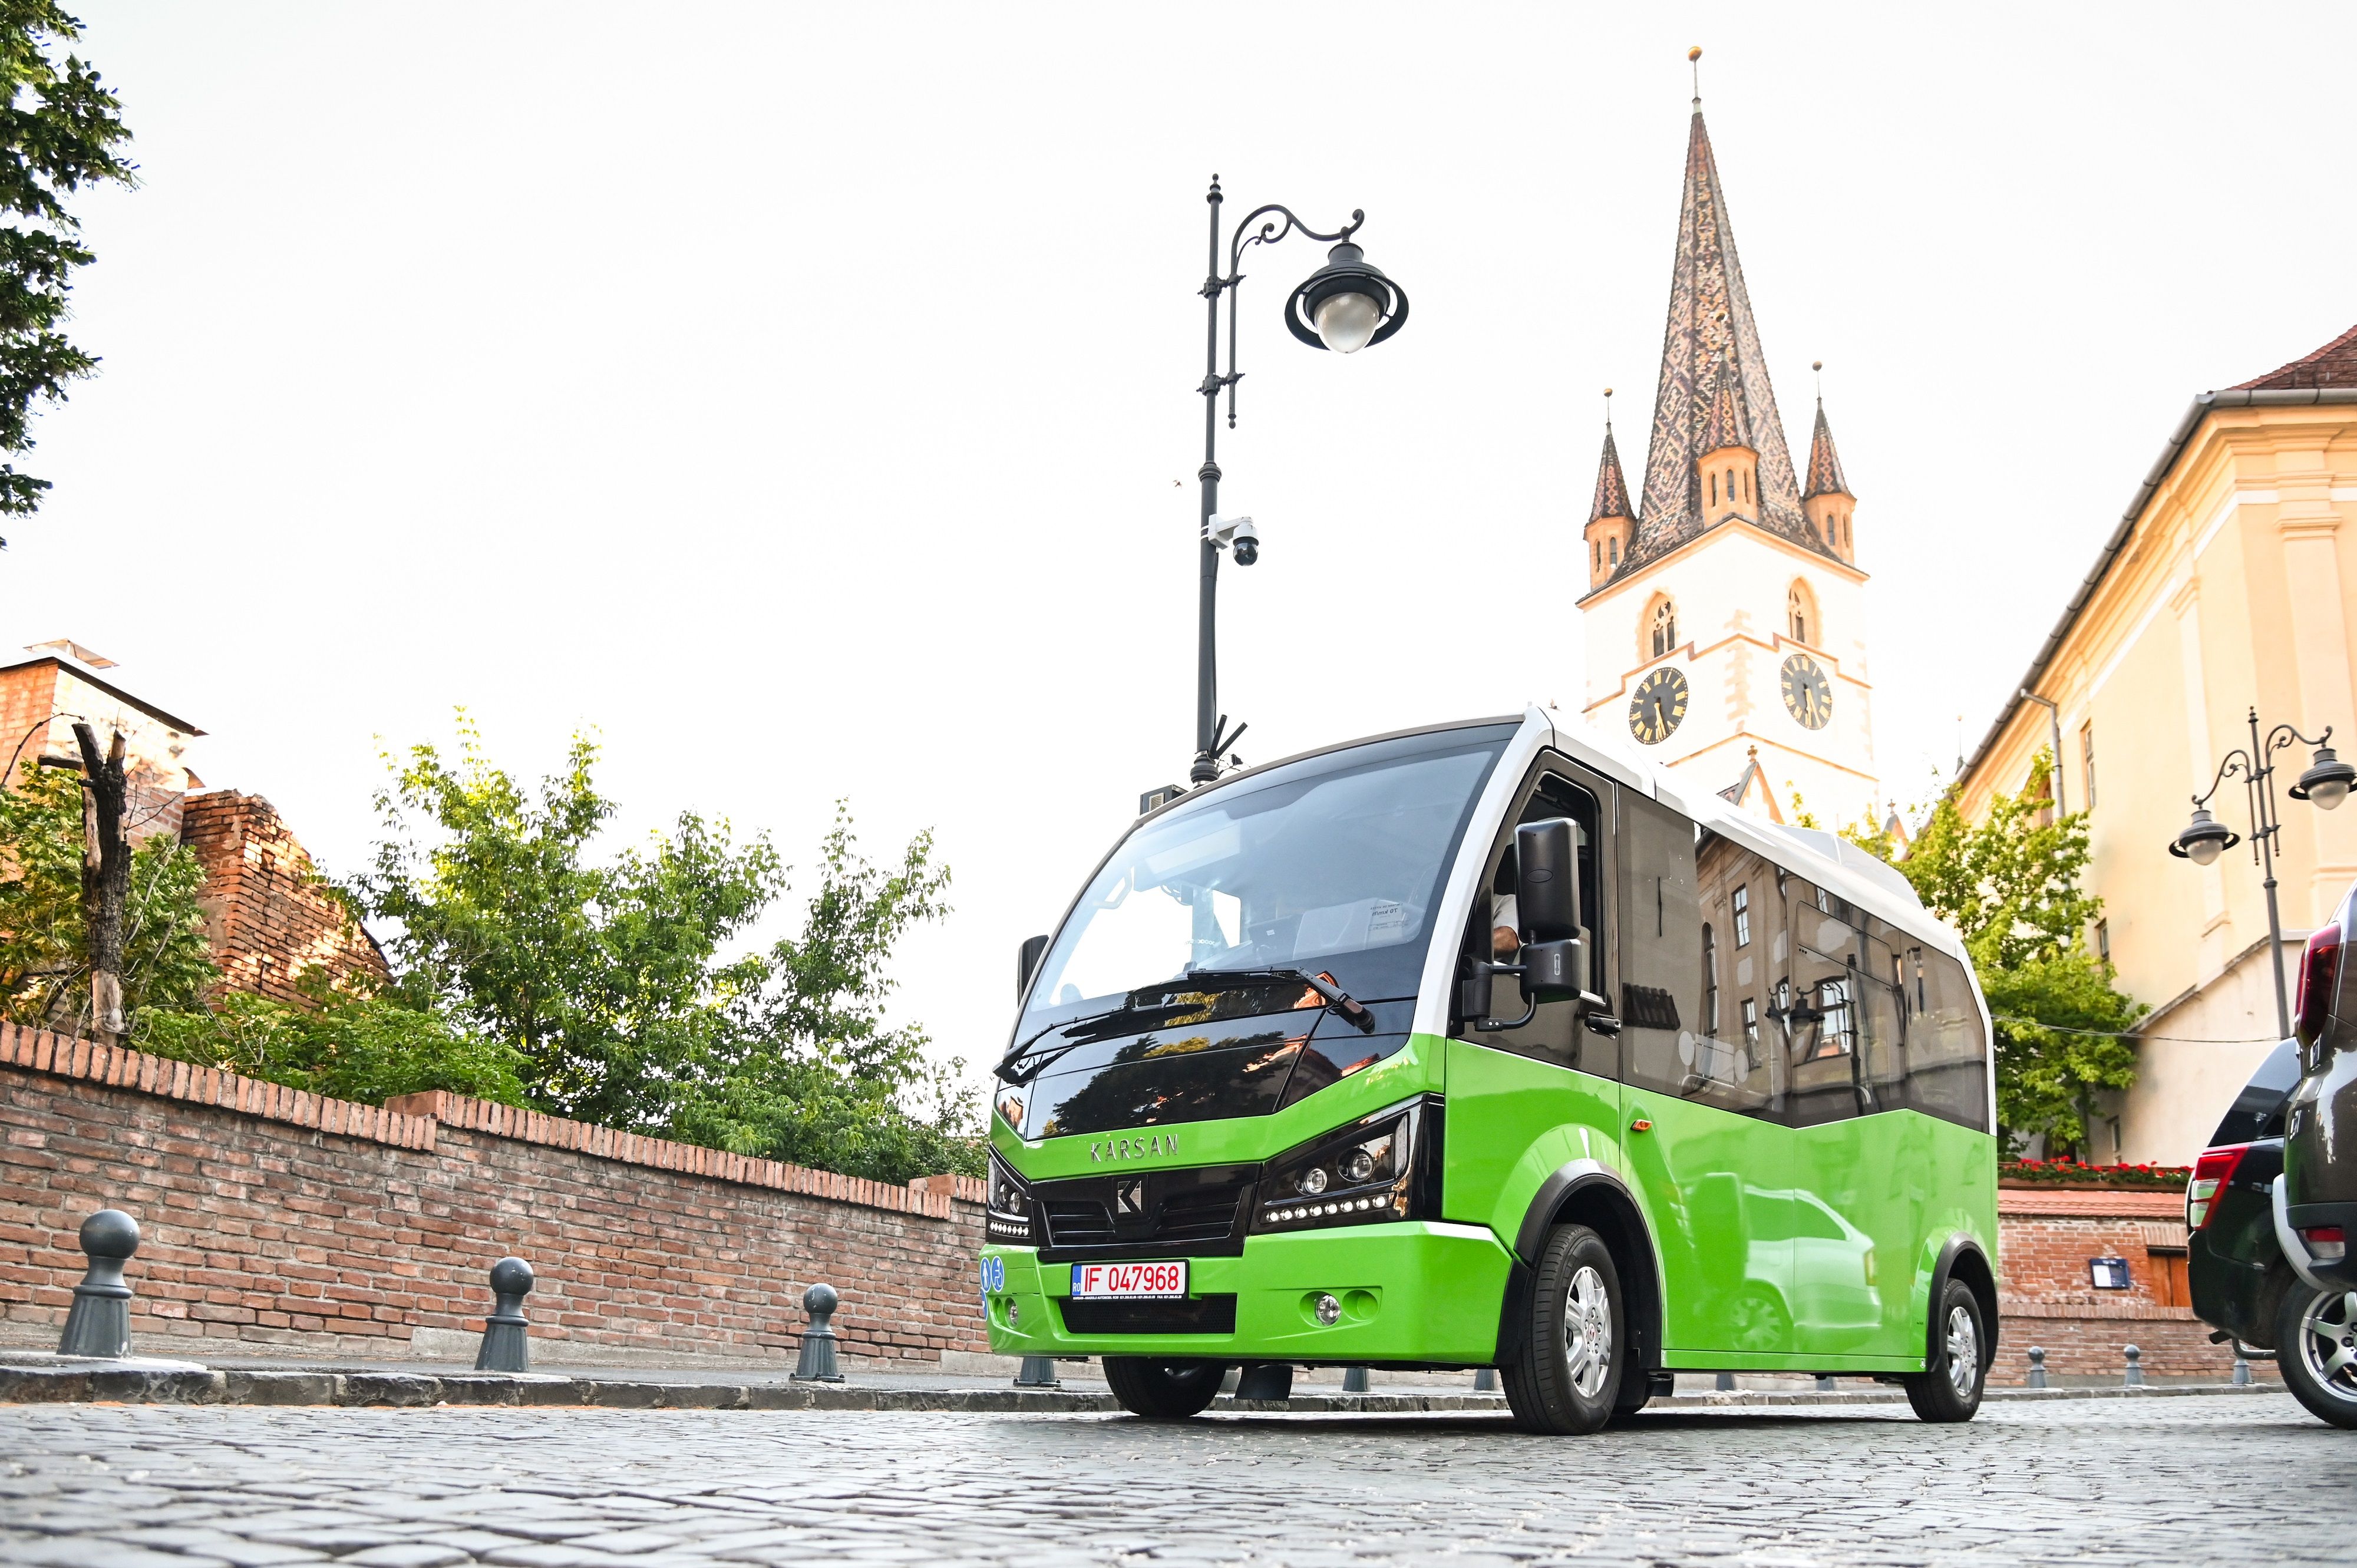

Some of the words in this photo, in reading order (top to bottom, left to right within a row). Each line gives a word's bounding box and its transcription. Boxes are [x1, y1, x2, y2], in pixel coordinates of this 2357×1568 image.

[1091, 1134, 1178, 1163] KARSAN
[1072, 1282, 1081, 1292] RO
[1084, 1267, 1102, 1292] IF
[1108, 1265, 1179, 1292] 047968
